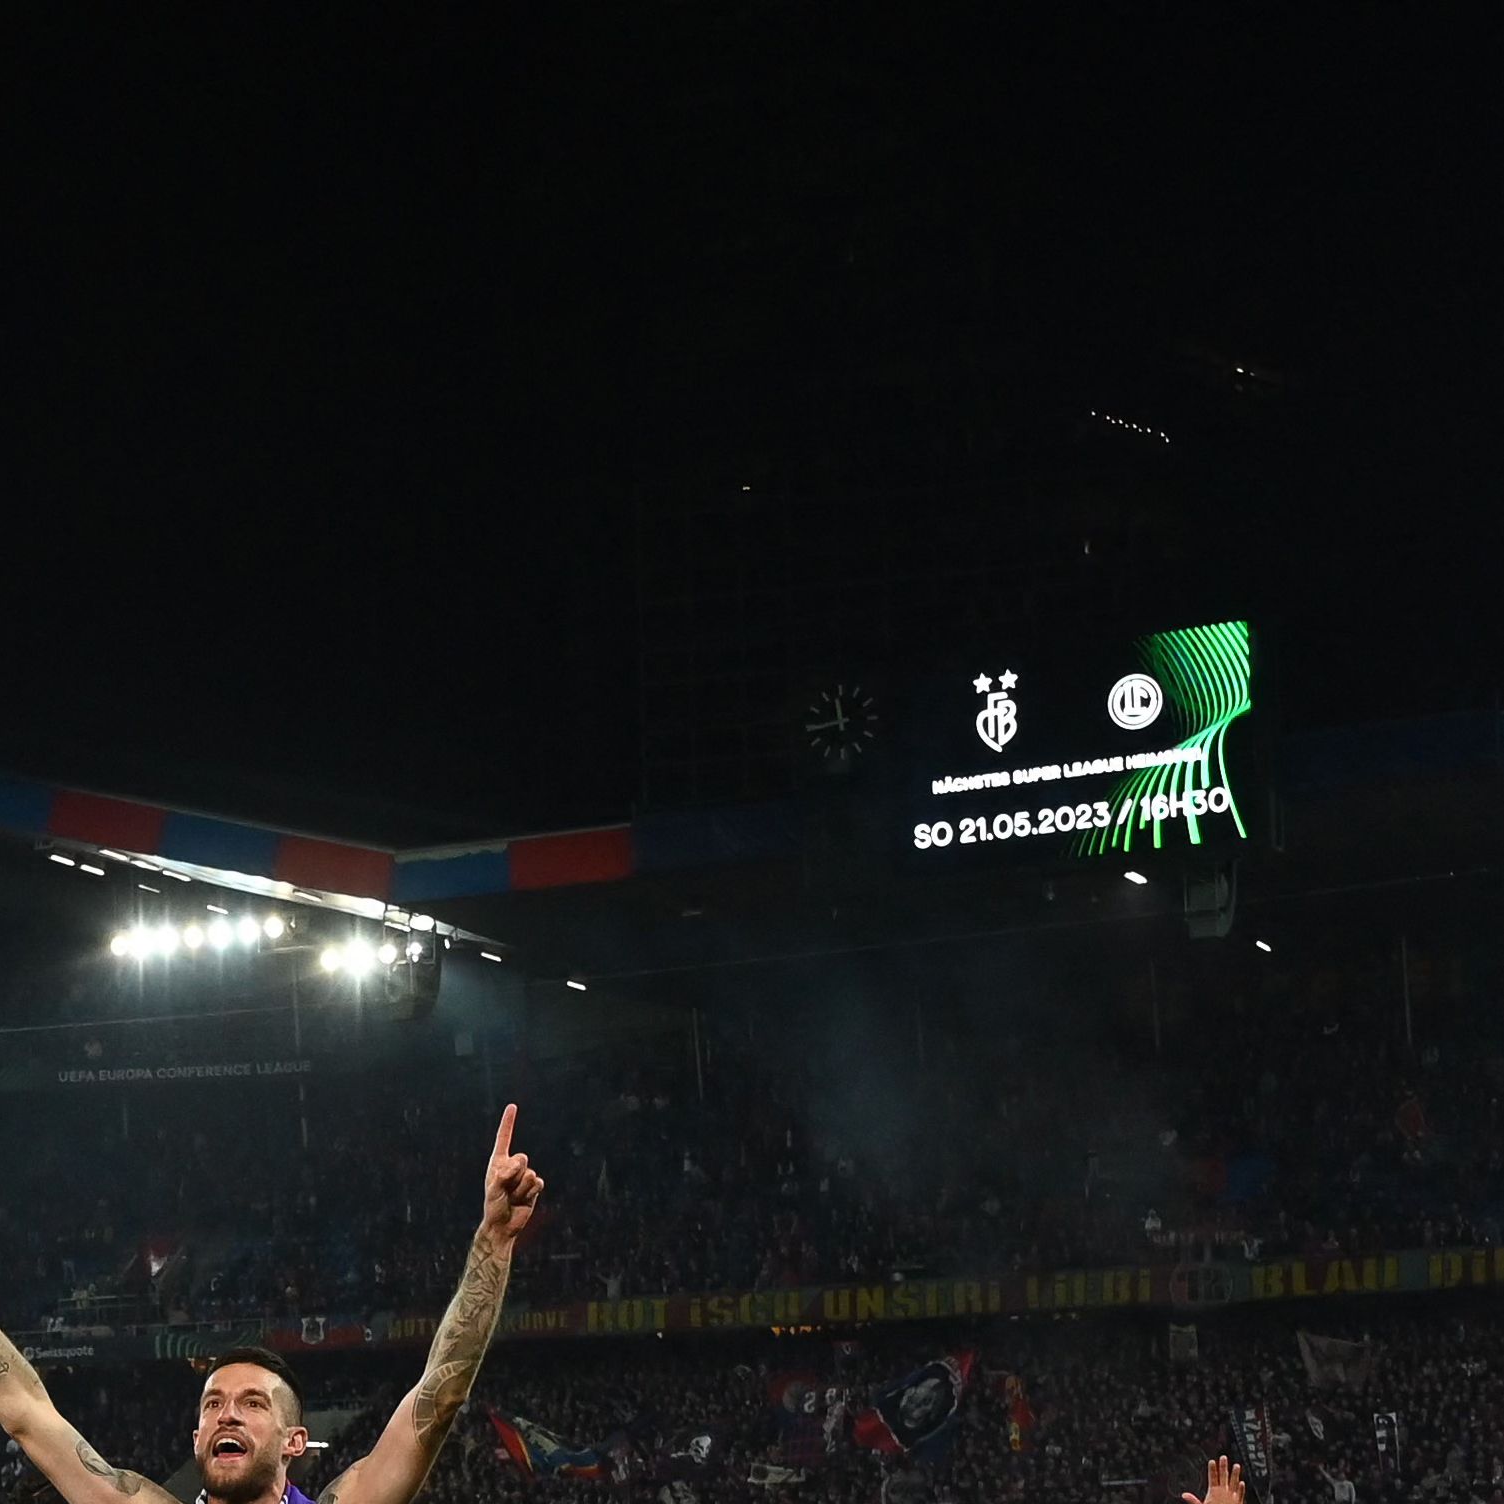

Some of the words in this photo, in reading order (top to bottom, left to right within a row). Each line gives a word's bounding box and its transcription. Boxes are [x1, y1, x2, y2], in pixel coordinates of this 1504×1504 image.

[1012, 765, 1062, 784] SUPER
[1063, 756, 1124, 778] LEAGUE
[913, 821, 953, 849] SO
[959, 801, 1111, 845] 21.05.2023
[1117, 798, 1133, 825] /
[1140, 786, 1230, 823] 16H30
[58, 1070, 99, 1083] UEFA
[98, 1068, 153, 1082] EUROPA
[156, 1062, 251, 1080] CONFERENCE
[256, 1060, 312, 1076] LEAGUE
